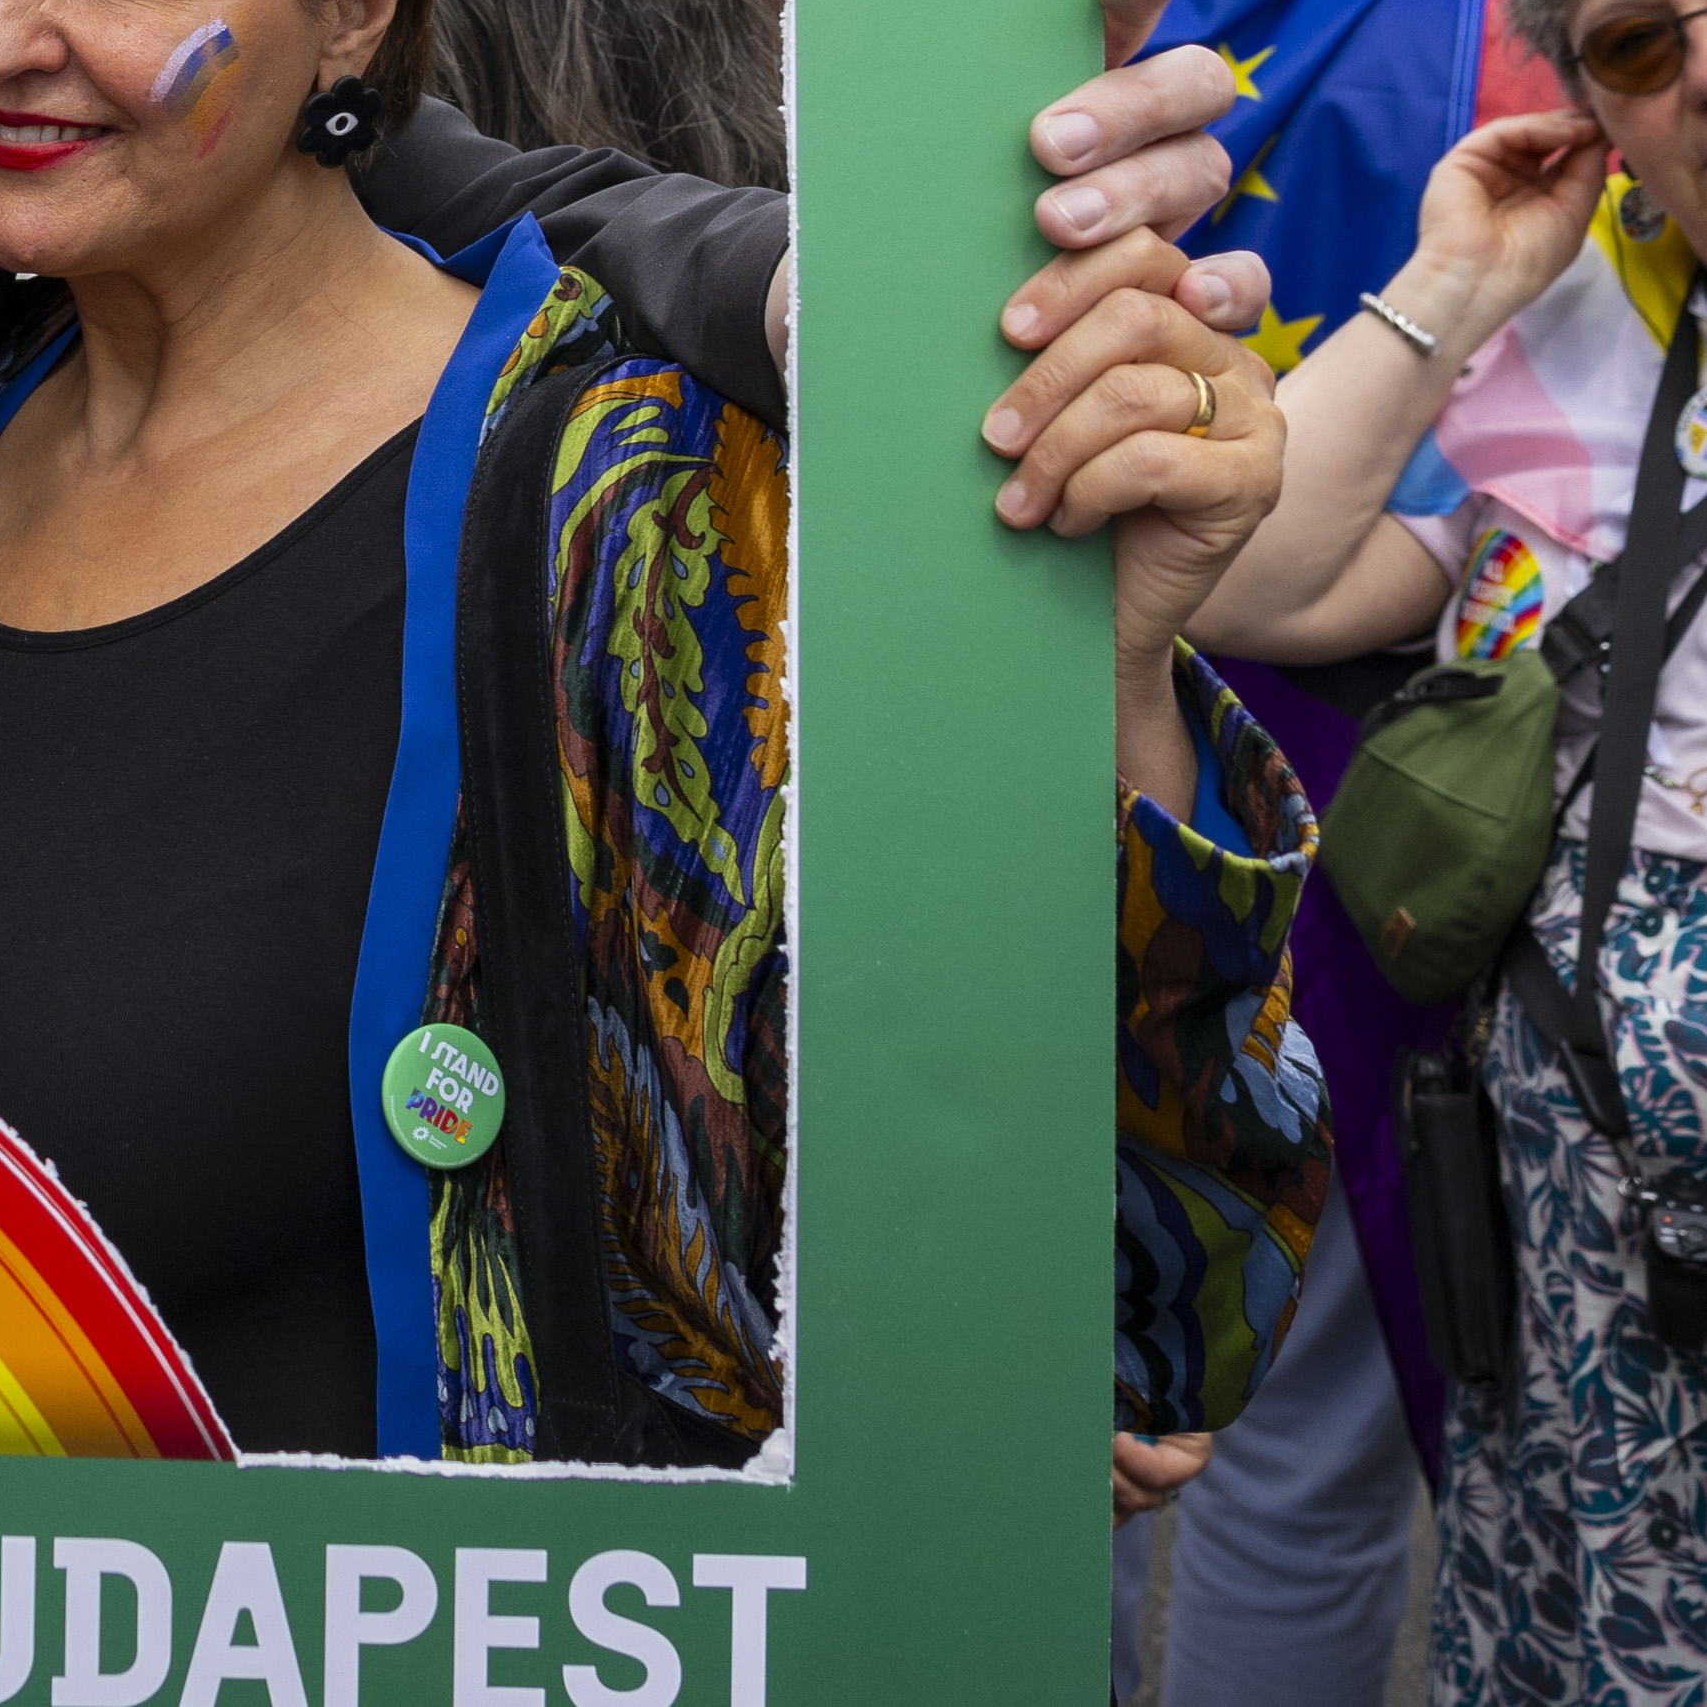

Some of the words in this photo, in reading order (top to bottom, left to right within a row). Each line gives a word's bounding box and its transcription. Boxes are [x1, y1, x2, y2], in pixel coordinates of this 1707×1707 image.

[419, 1031, 432, 1053] I
[431, 1041, 499, 1097] STAND
[425, 1066, 474, 1115] FOR
[405, 1087, 472, 1145] PRIDE
